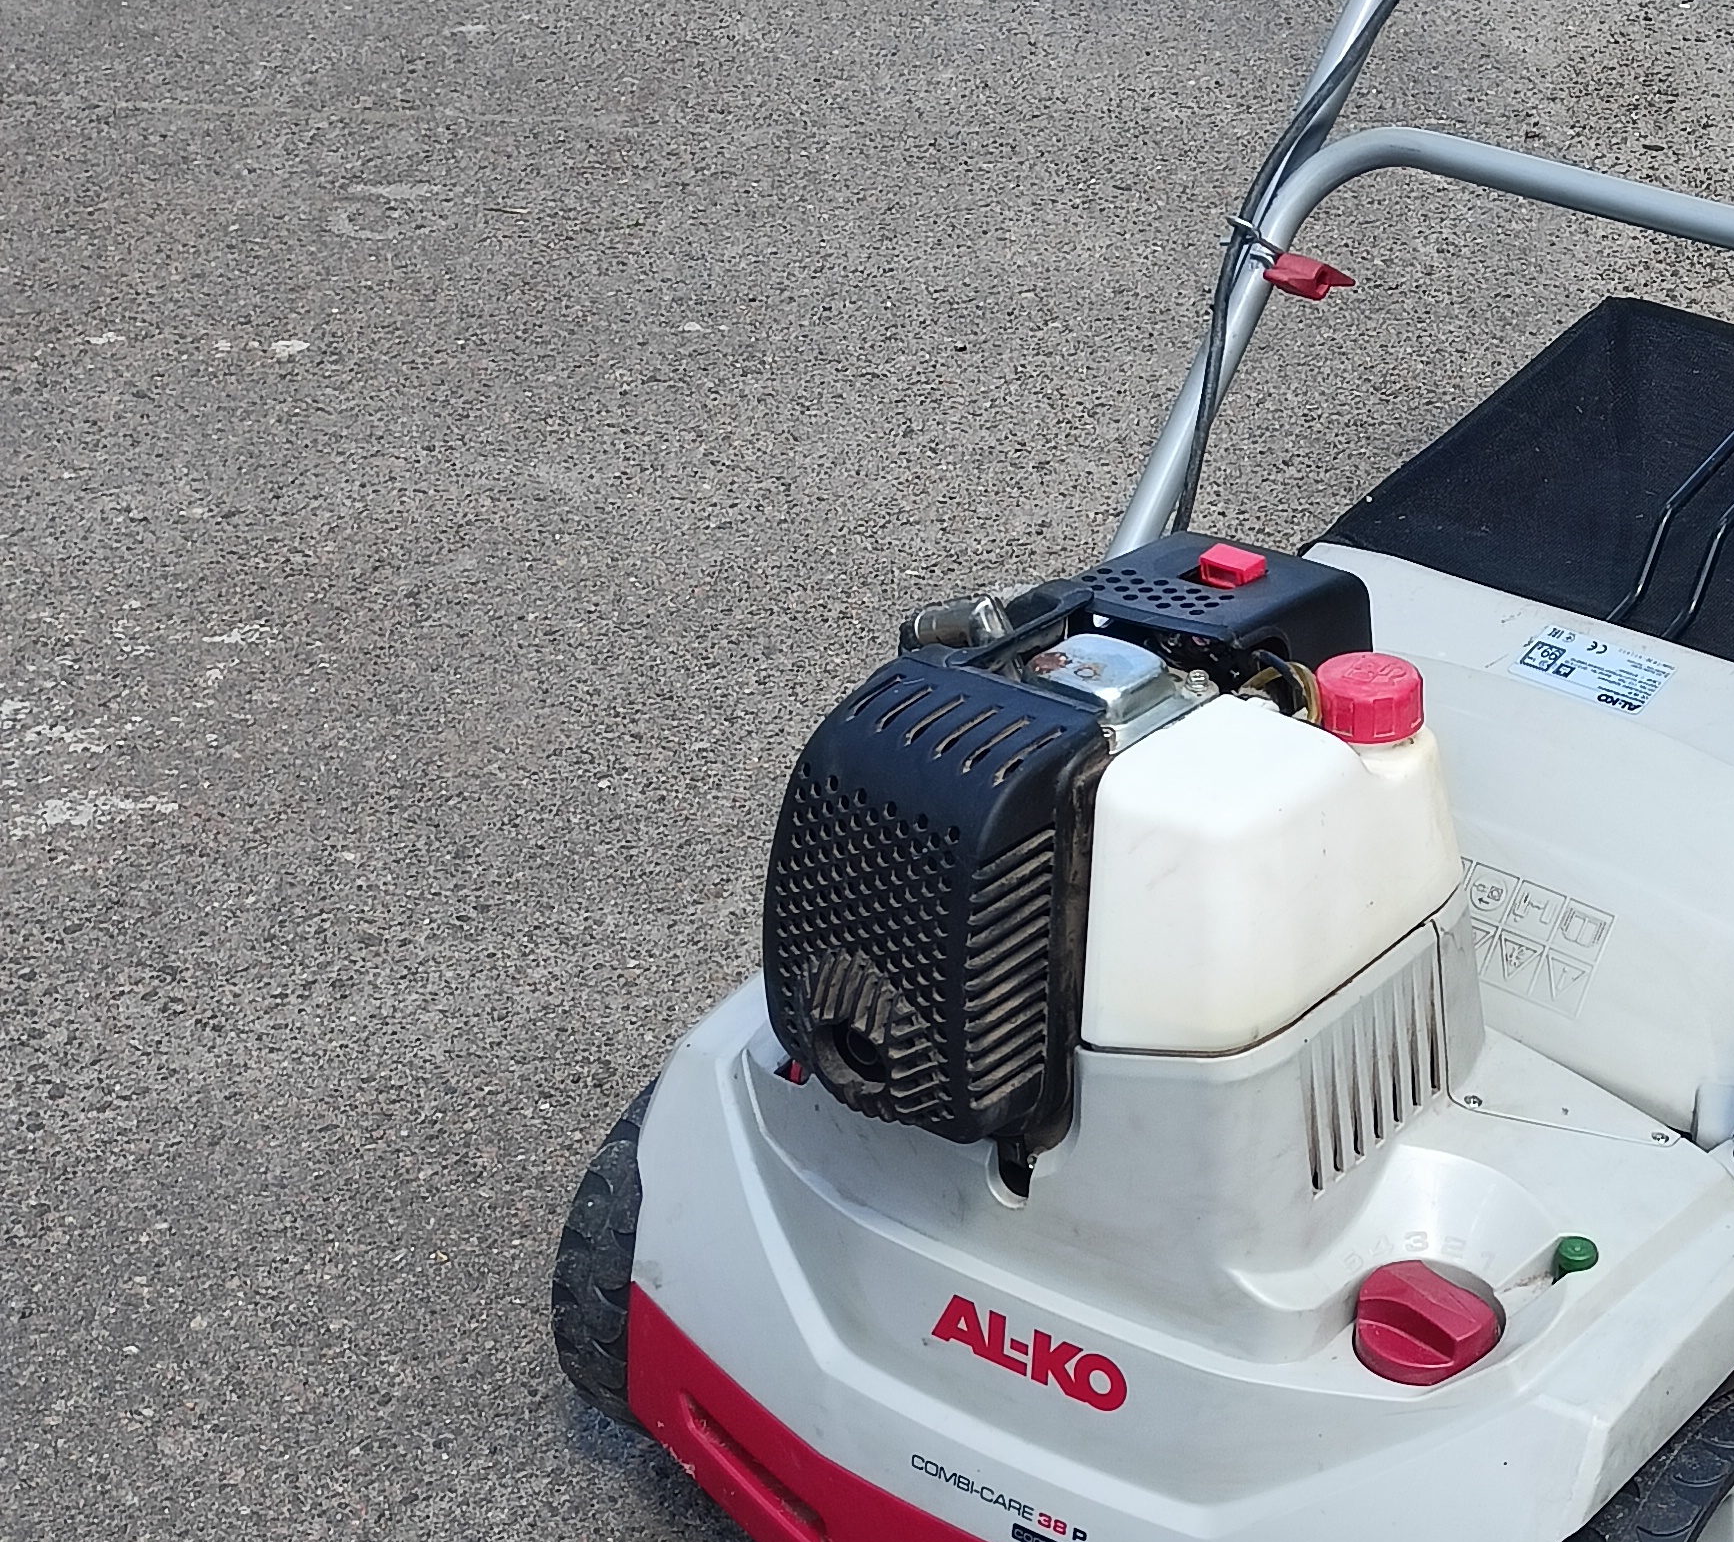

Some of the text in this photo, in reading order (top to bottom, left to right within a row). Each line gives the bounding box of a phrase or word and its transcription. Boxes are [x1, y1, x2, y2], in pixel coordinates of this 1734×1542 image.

[1404, 1231, 1429, 1252] 3
[1441, 1235, 1467, 1259] 2
[931, 1294, 1128, 1412] AL-KO
[911, 1454, 1087, 1542] COMBI-CARE 38 P
